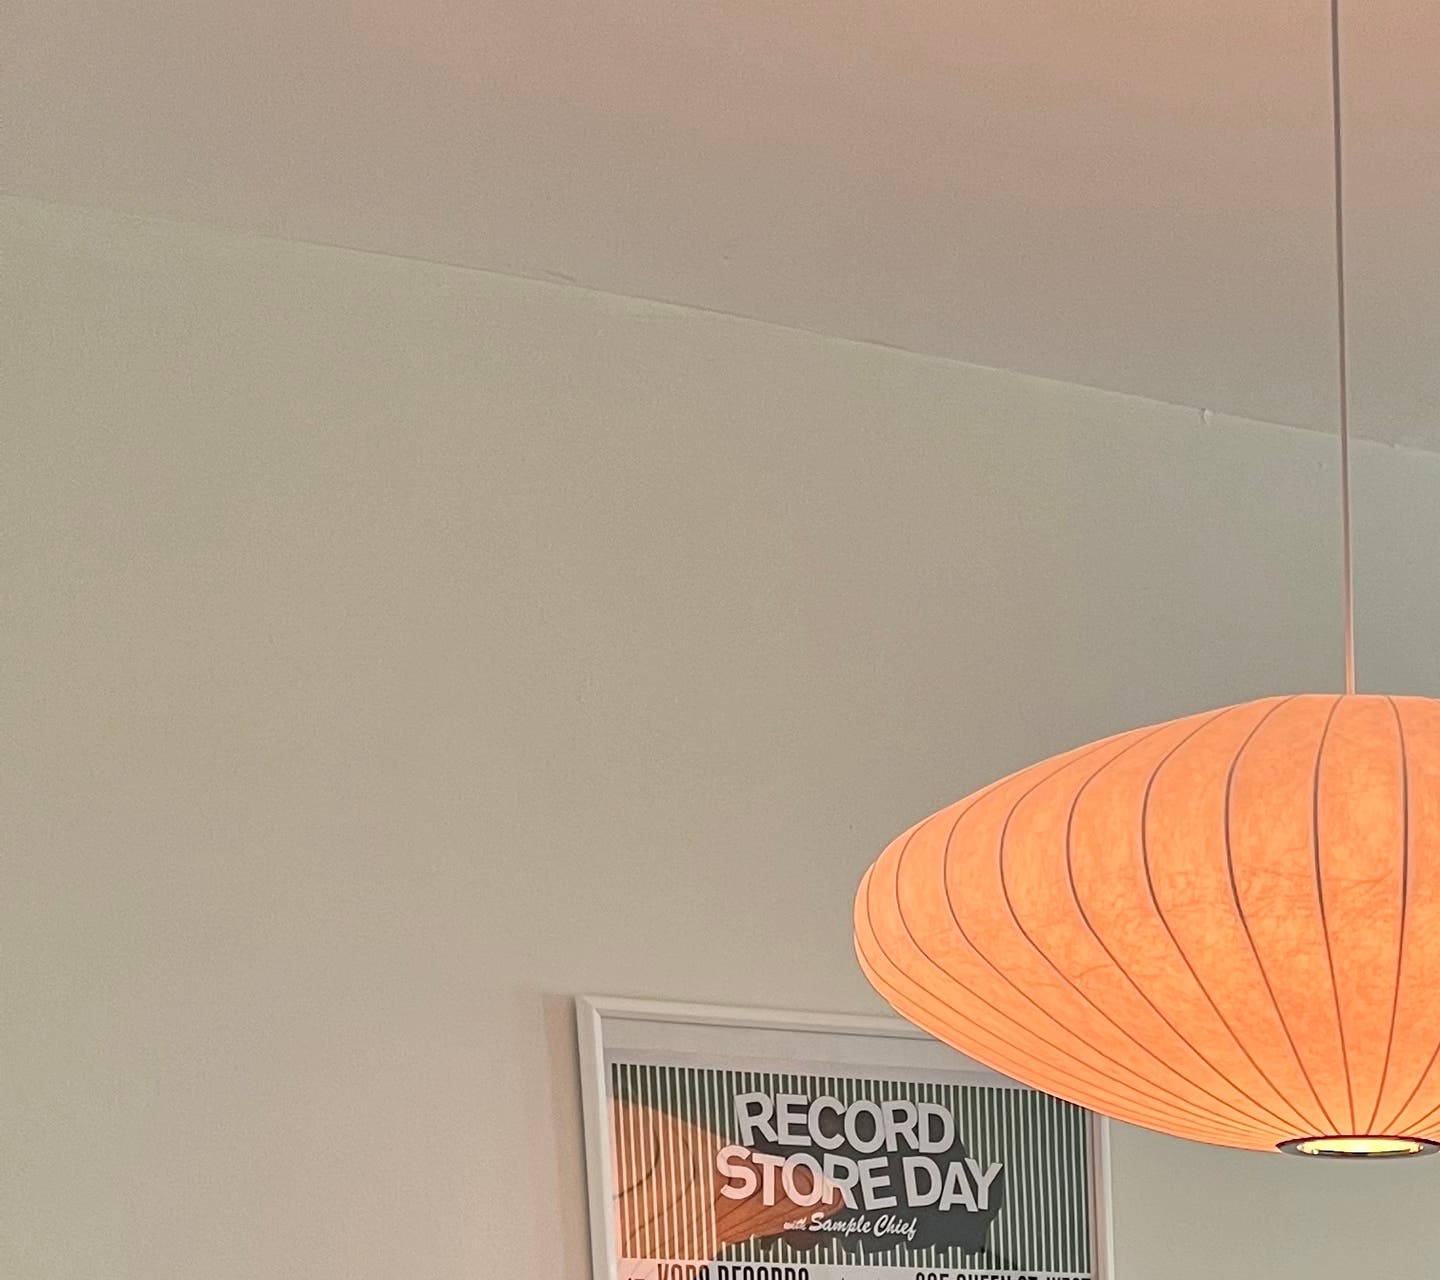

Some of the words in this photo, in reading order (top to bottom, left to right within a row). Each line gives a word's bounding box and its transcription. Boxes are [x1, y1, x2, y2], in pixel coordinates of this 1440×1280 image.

[734, 1091, 956, 1154] RECORD
[716, 1145, 898, 1211] STORE
[901, 1155, 1004, 1213] DAY
[809, 1212, 872, 1237] Sample
[873, 1213, 917, 1242] Chief
